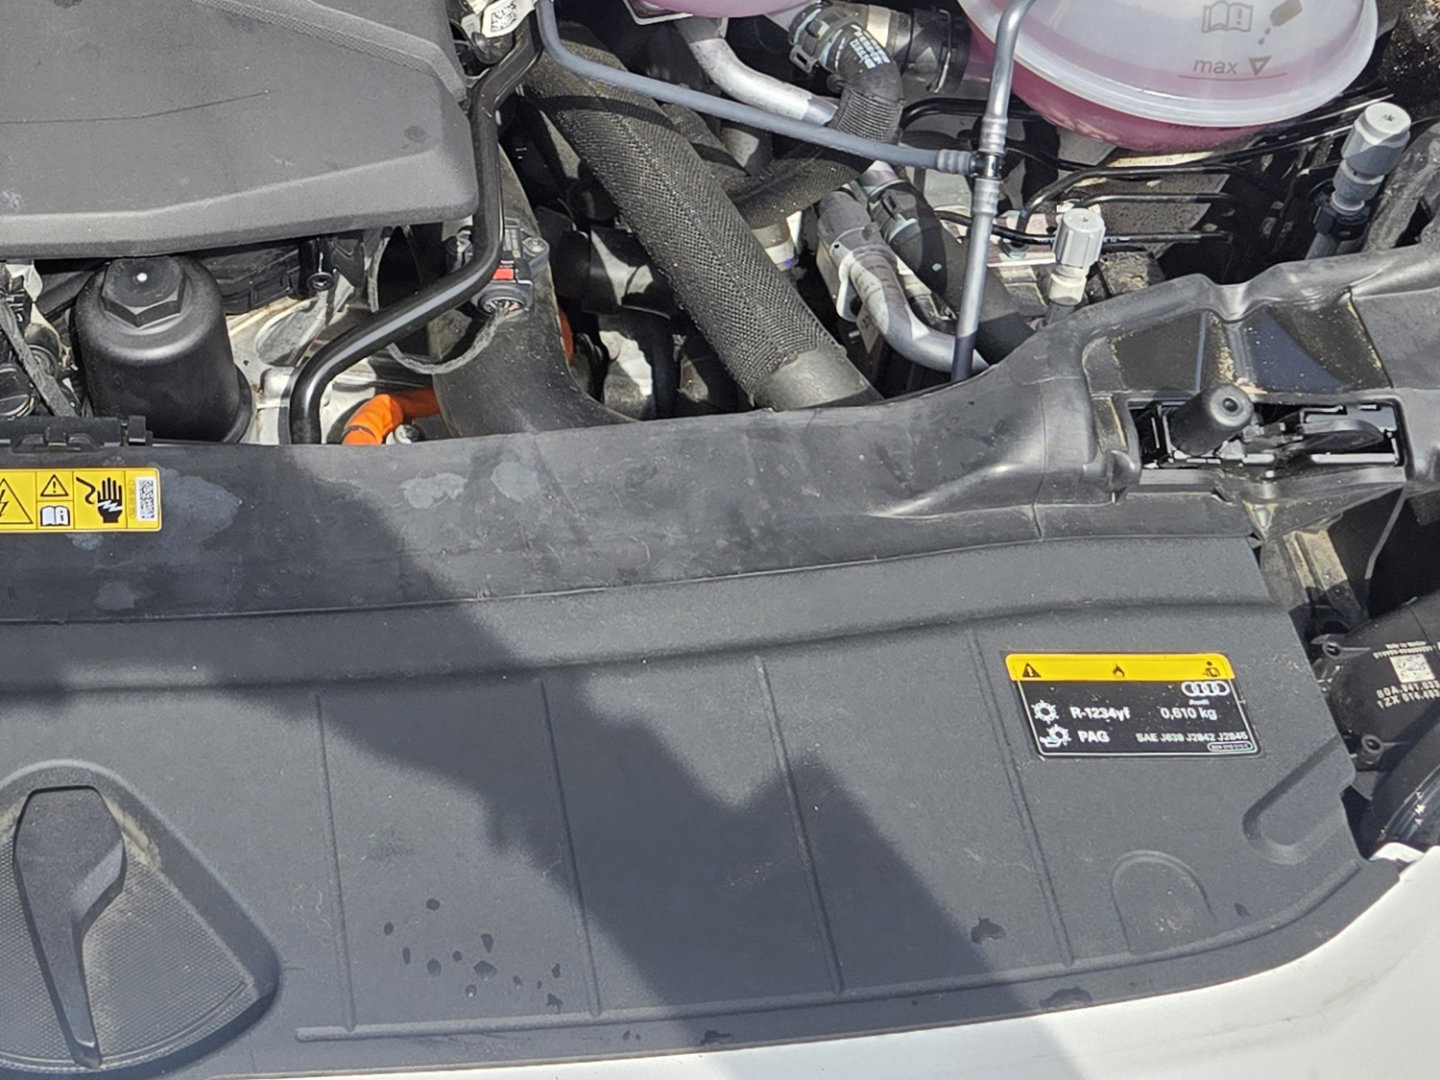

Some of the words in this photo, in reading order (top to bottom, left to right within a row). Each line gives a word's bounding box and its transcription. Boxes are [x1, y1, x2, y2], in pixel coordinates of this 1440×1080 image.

[1192, 59, 1239, 75] max
[1069, 706, 1131, 721] R-1234yf
[1160, 707, 1197, 720] 0,610
[1198, 707, 1218, 721] kg
[1077, 730, 1110, 743] PAG
[1135, 733, 1159, 742] SAE
